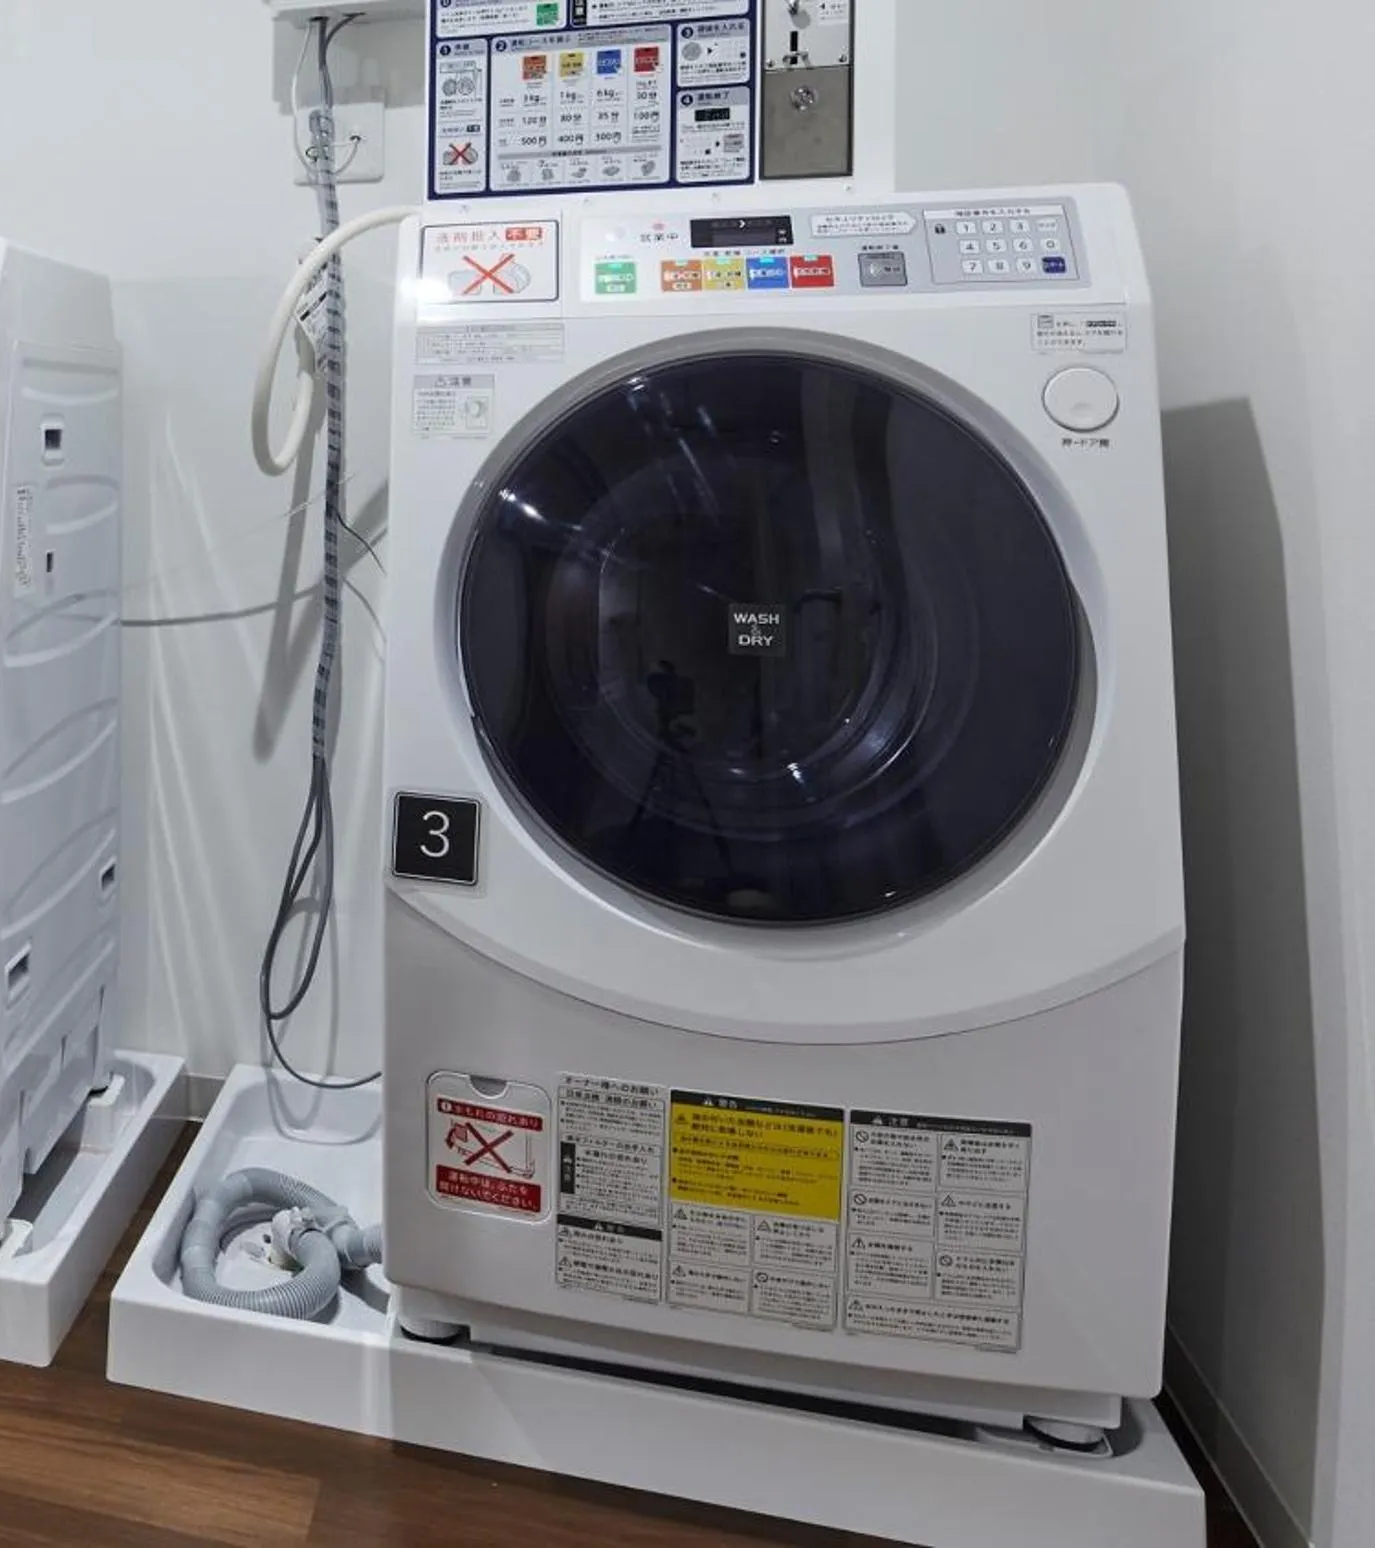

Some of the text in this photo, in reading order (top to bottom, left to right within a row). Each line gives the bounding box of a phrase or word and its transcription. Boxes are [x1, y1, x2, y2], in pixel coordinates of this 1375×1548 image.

[733, 612, 780, 624] WASH
[738, 634, 773, 646] DRY
[420, 810, 450, 858] 3
